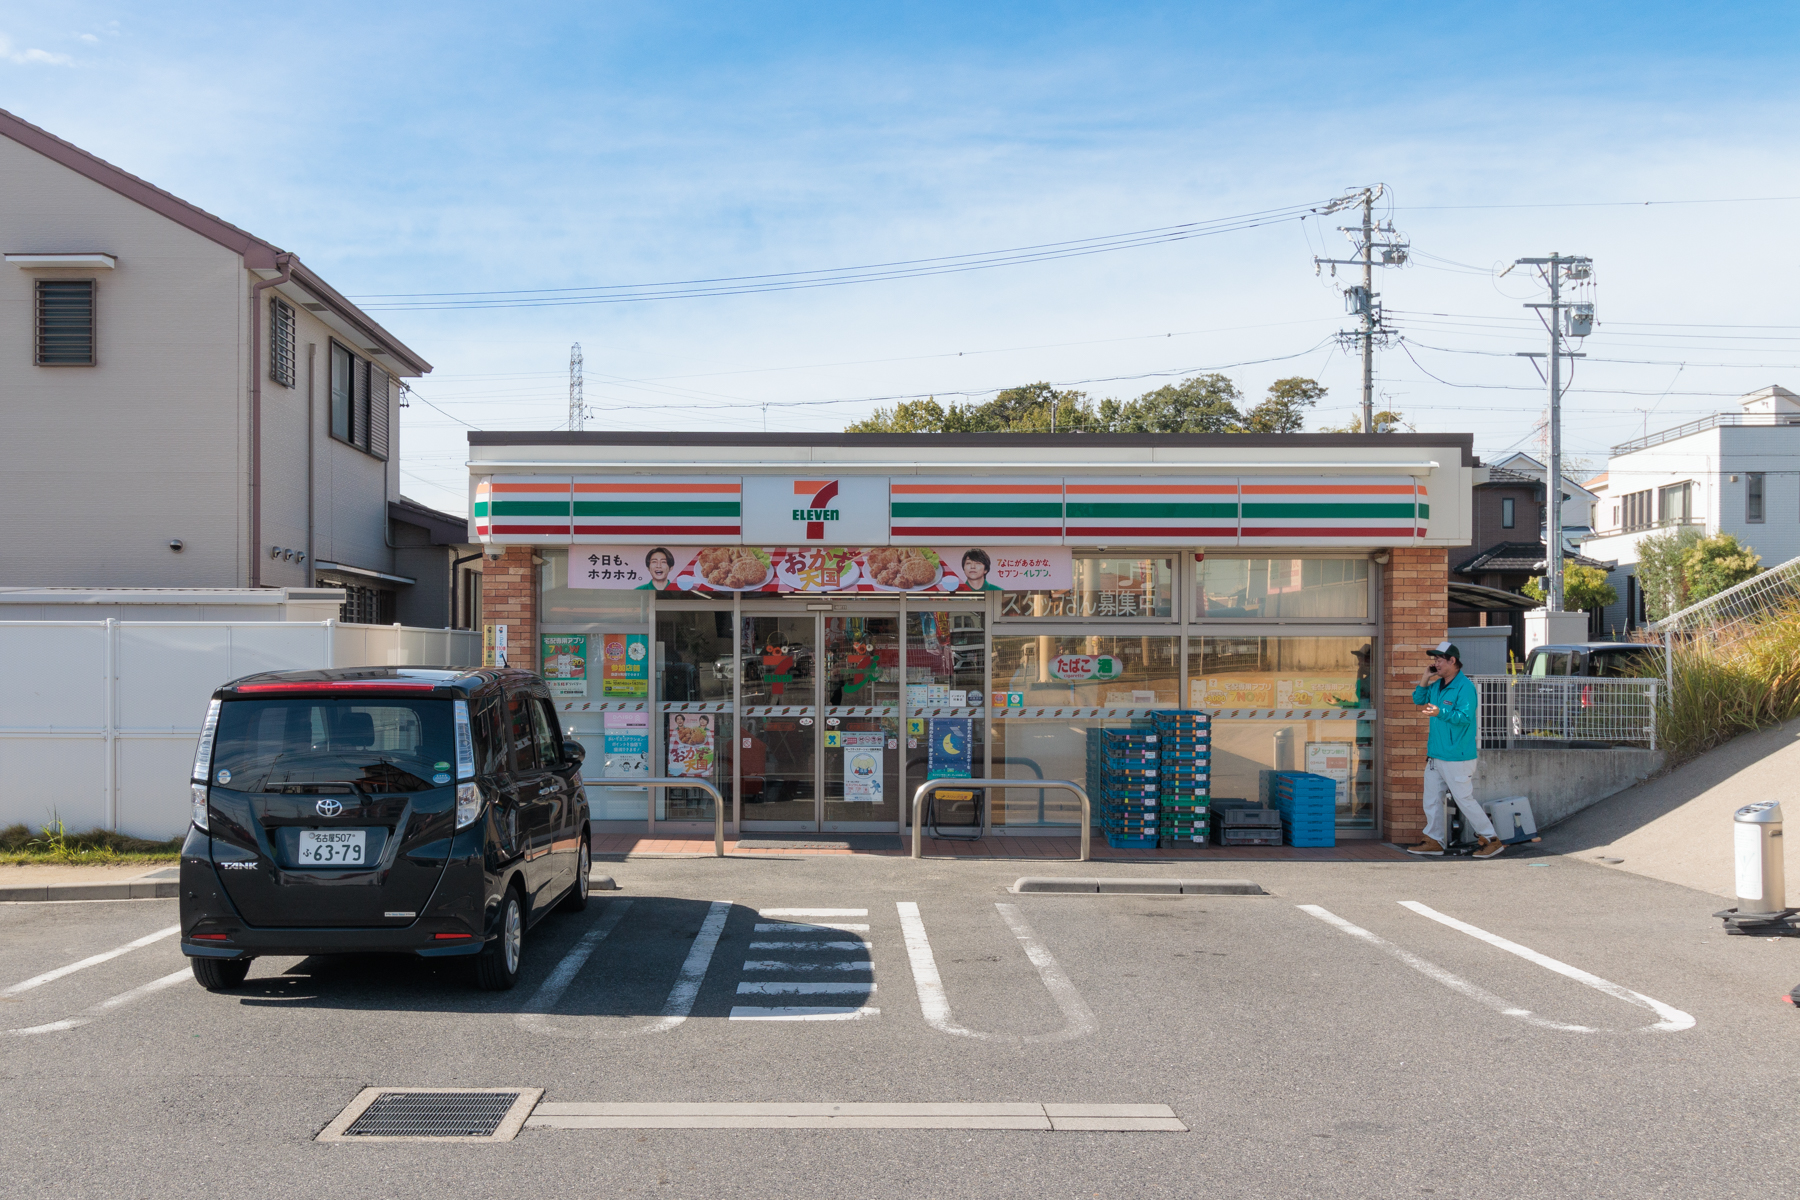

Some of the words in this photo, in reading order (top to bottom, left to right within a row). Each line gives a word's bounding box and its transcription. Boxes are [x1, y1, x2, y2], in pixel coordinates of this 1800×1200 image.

[588, 553, 629, 566] 今日も、
[785, 548, 861, 575] おかず
[588, 568, 643, 581] ホカホカ。
[797, 567, 841, 591] 天国
[1002, 590, 1156, 617] スタッフさん募集中
[548, 645, 580, 654] 7NOW
[1057, 658, 1091, 673] たばこ
[1097, 658, 1113, 673] 酒
[1229, 691, 1267, 702] 7NOW
[670, 747, 711, 762] おかず
[683, 759, 708, 773] 天国
[315, 833, 335, 843] 名古屋
[335, 833, 352, 843] 507
[303, 848, 312, 857] ふ
[313, 844, 361, 861] 63-79
[220, 862, 258, 870] TANK
